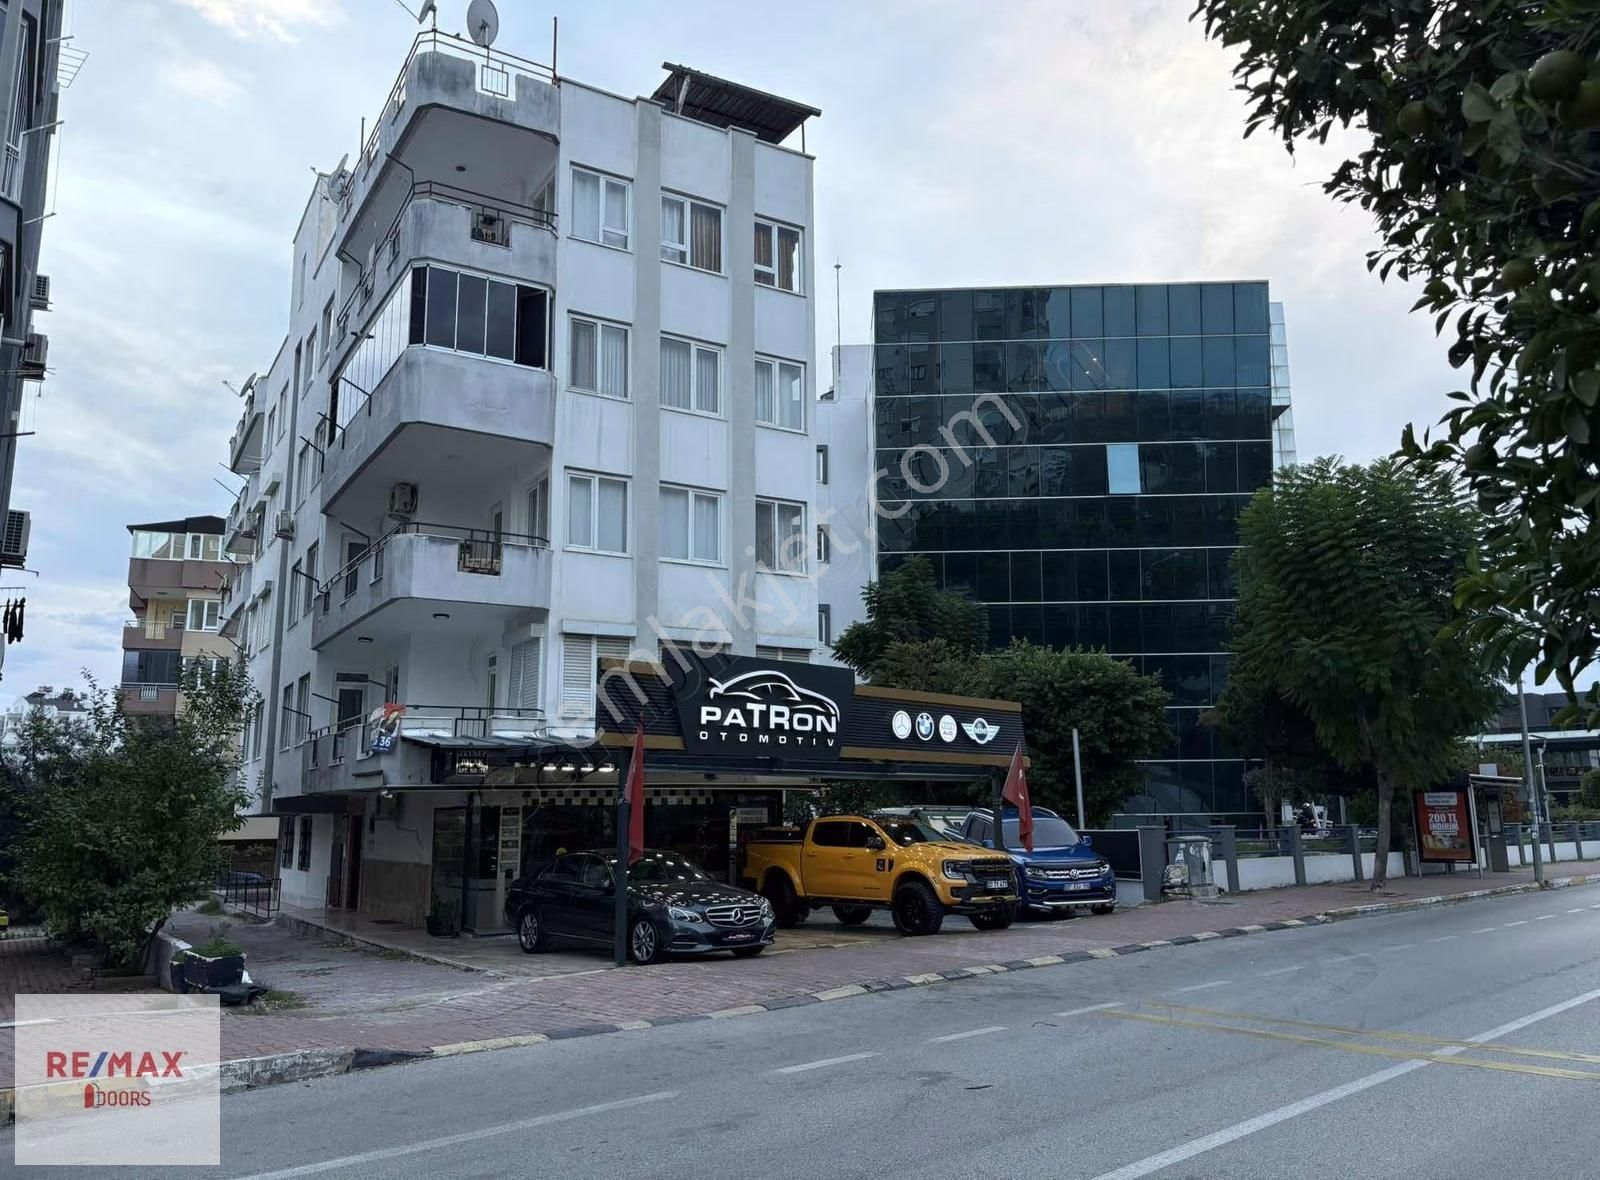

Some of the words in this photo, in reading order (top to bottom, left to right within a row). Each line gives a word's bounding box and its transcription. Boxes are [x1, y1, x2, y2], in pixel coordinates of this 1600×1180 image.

[700, 702, 837, 733] PATRON
[699, 731, 835, 747] OTOMOTİV
[1428, 813, 1446, 823] 200
[1447, 813, 1457, 823] TL
